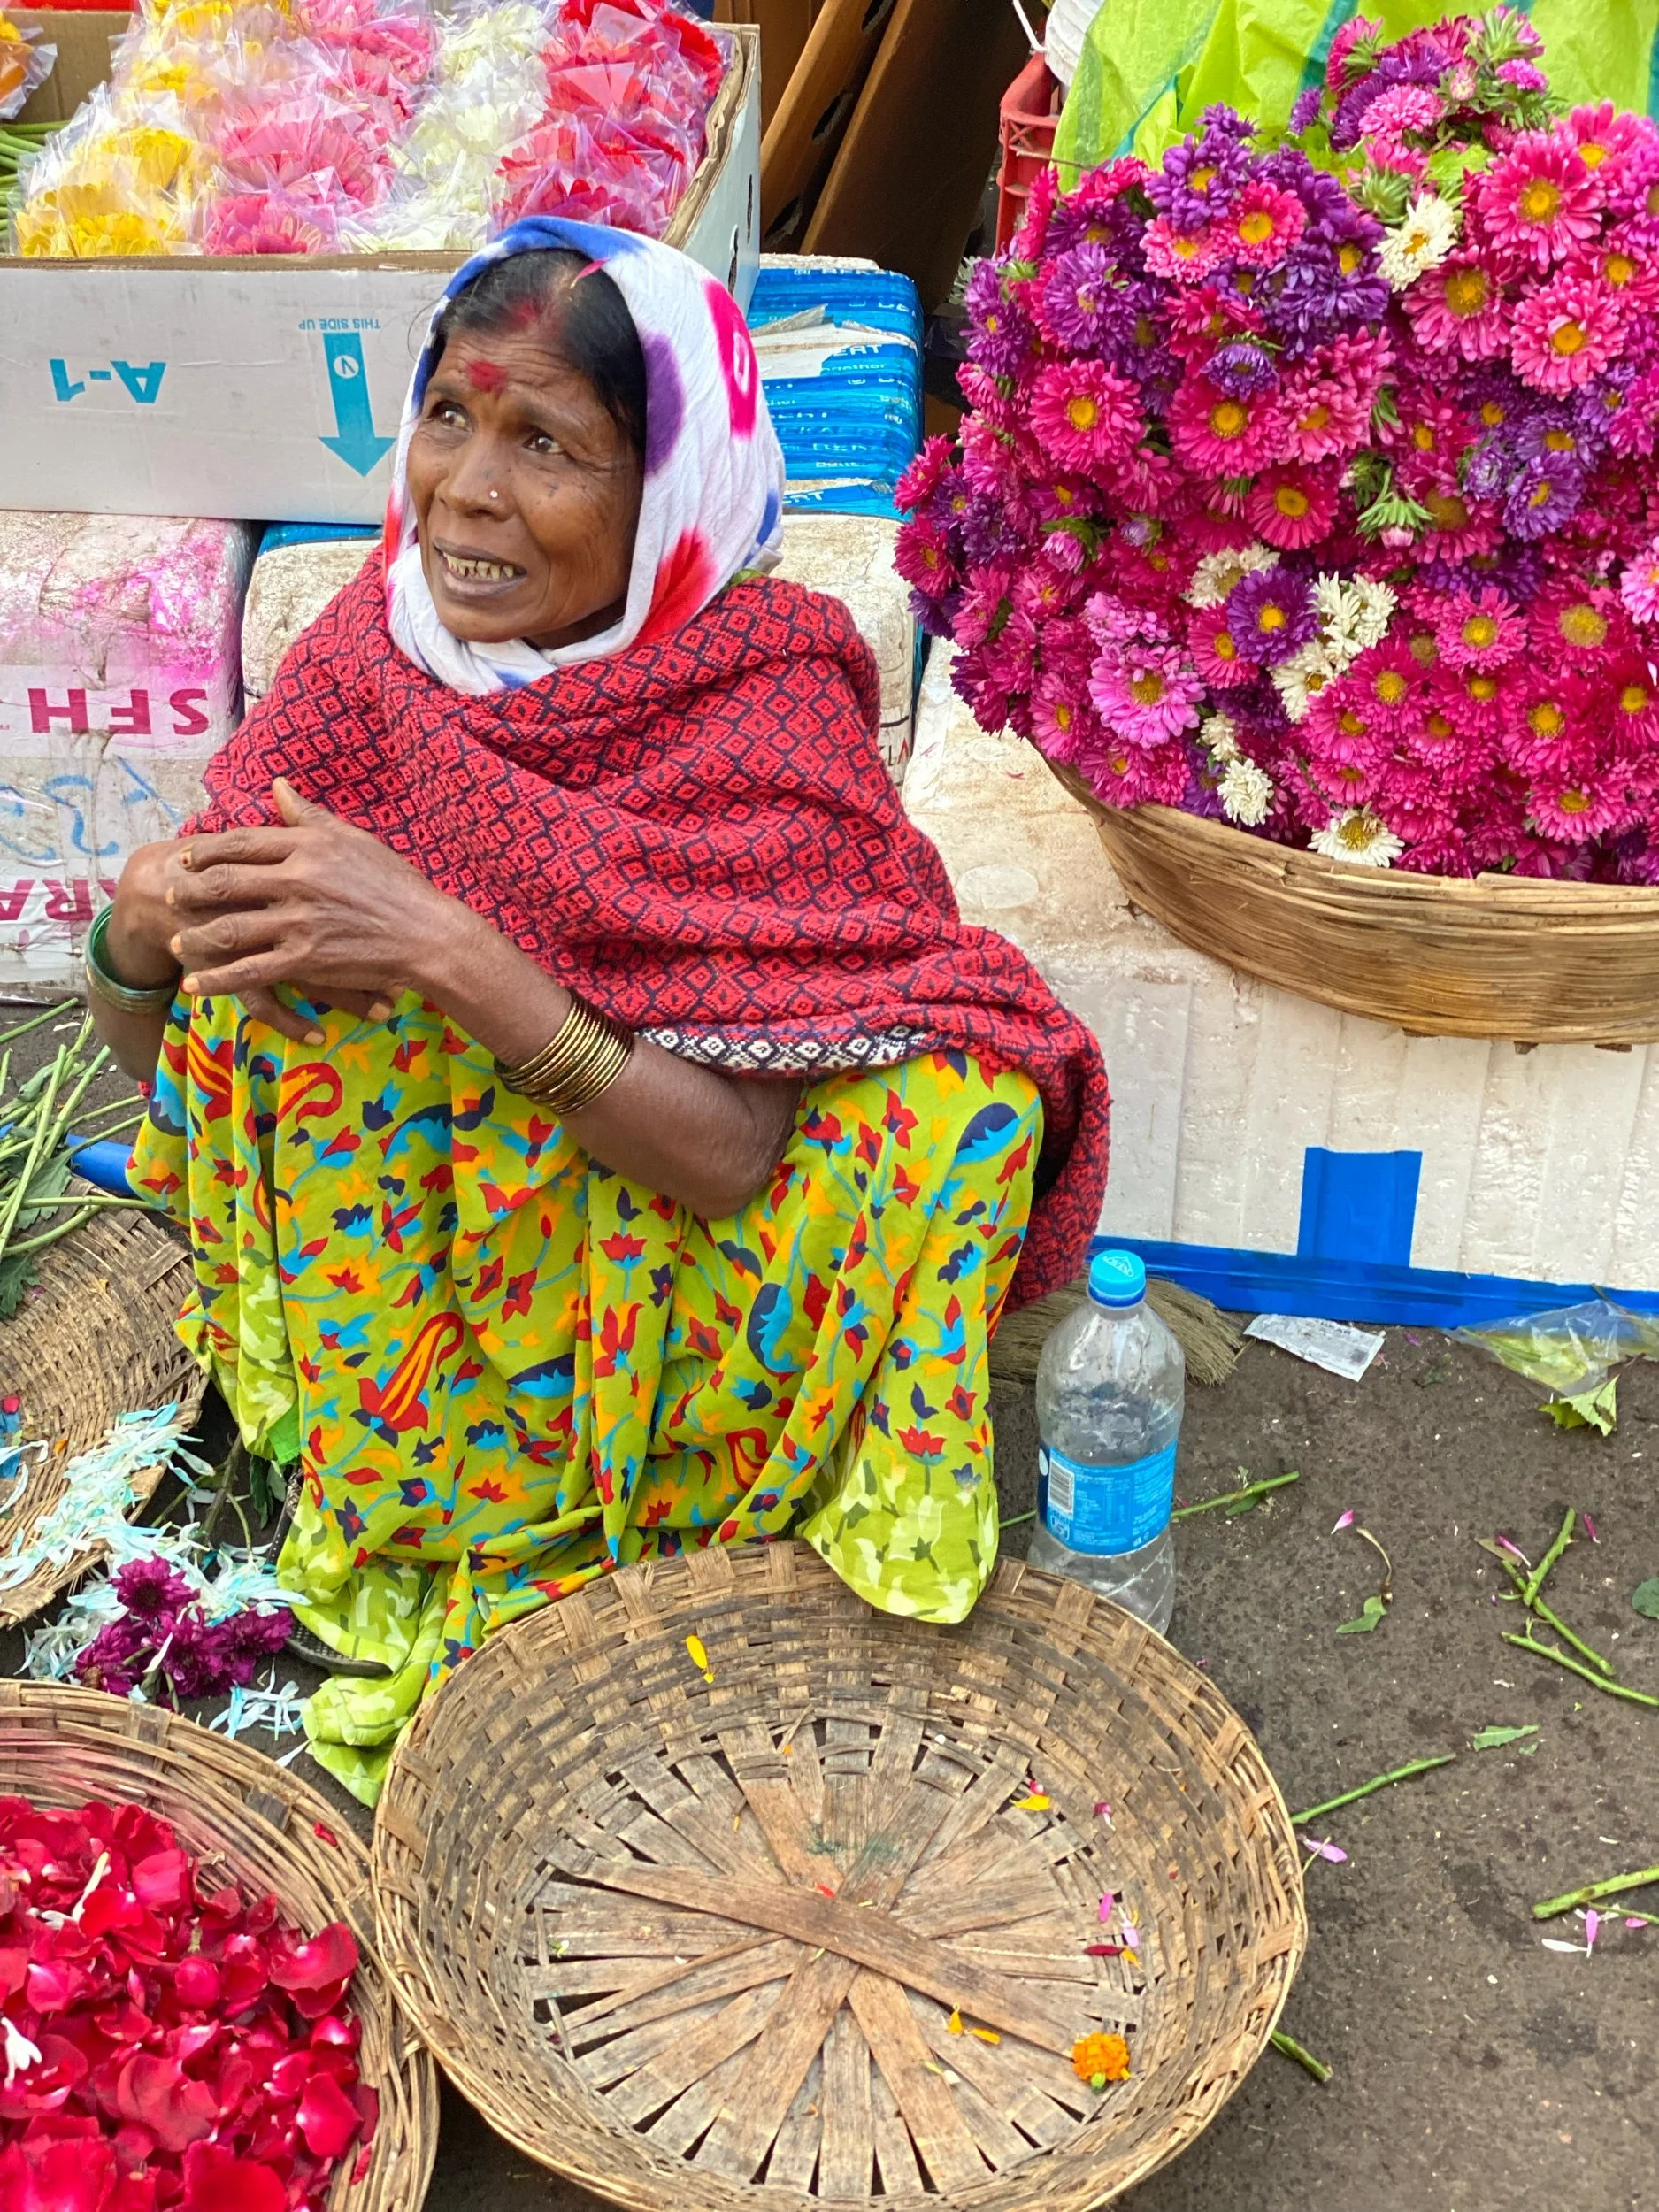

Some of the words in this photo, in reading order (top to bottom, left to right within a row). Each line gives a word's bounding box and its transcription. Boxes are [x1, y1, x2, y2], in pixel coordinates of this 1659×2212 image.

[297, 319, 317, 331] UP
[319, 318, 349, 331] SIDE
[352, 318, 381, 330] THIS
[50, 358, 166, 403] A-1
[27, 687, 210, 736] SFH
[0, 879, 117, 921] RA
